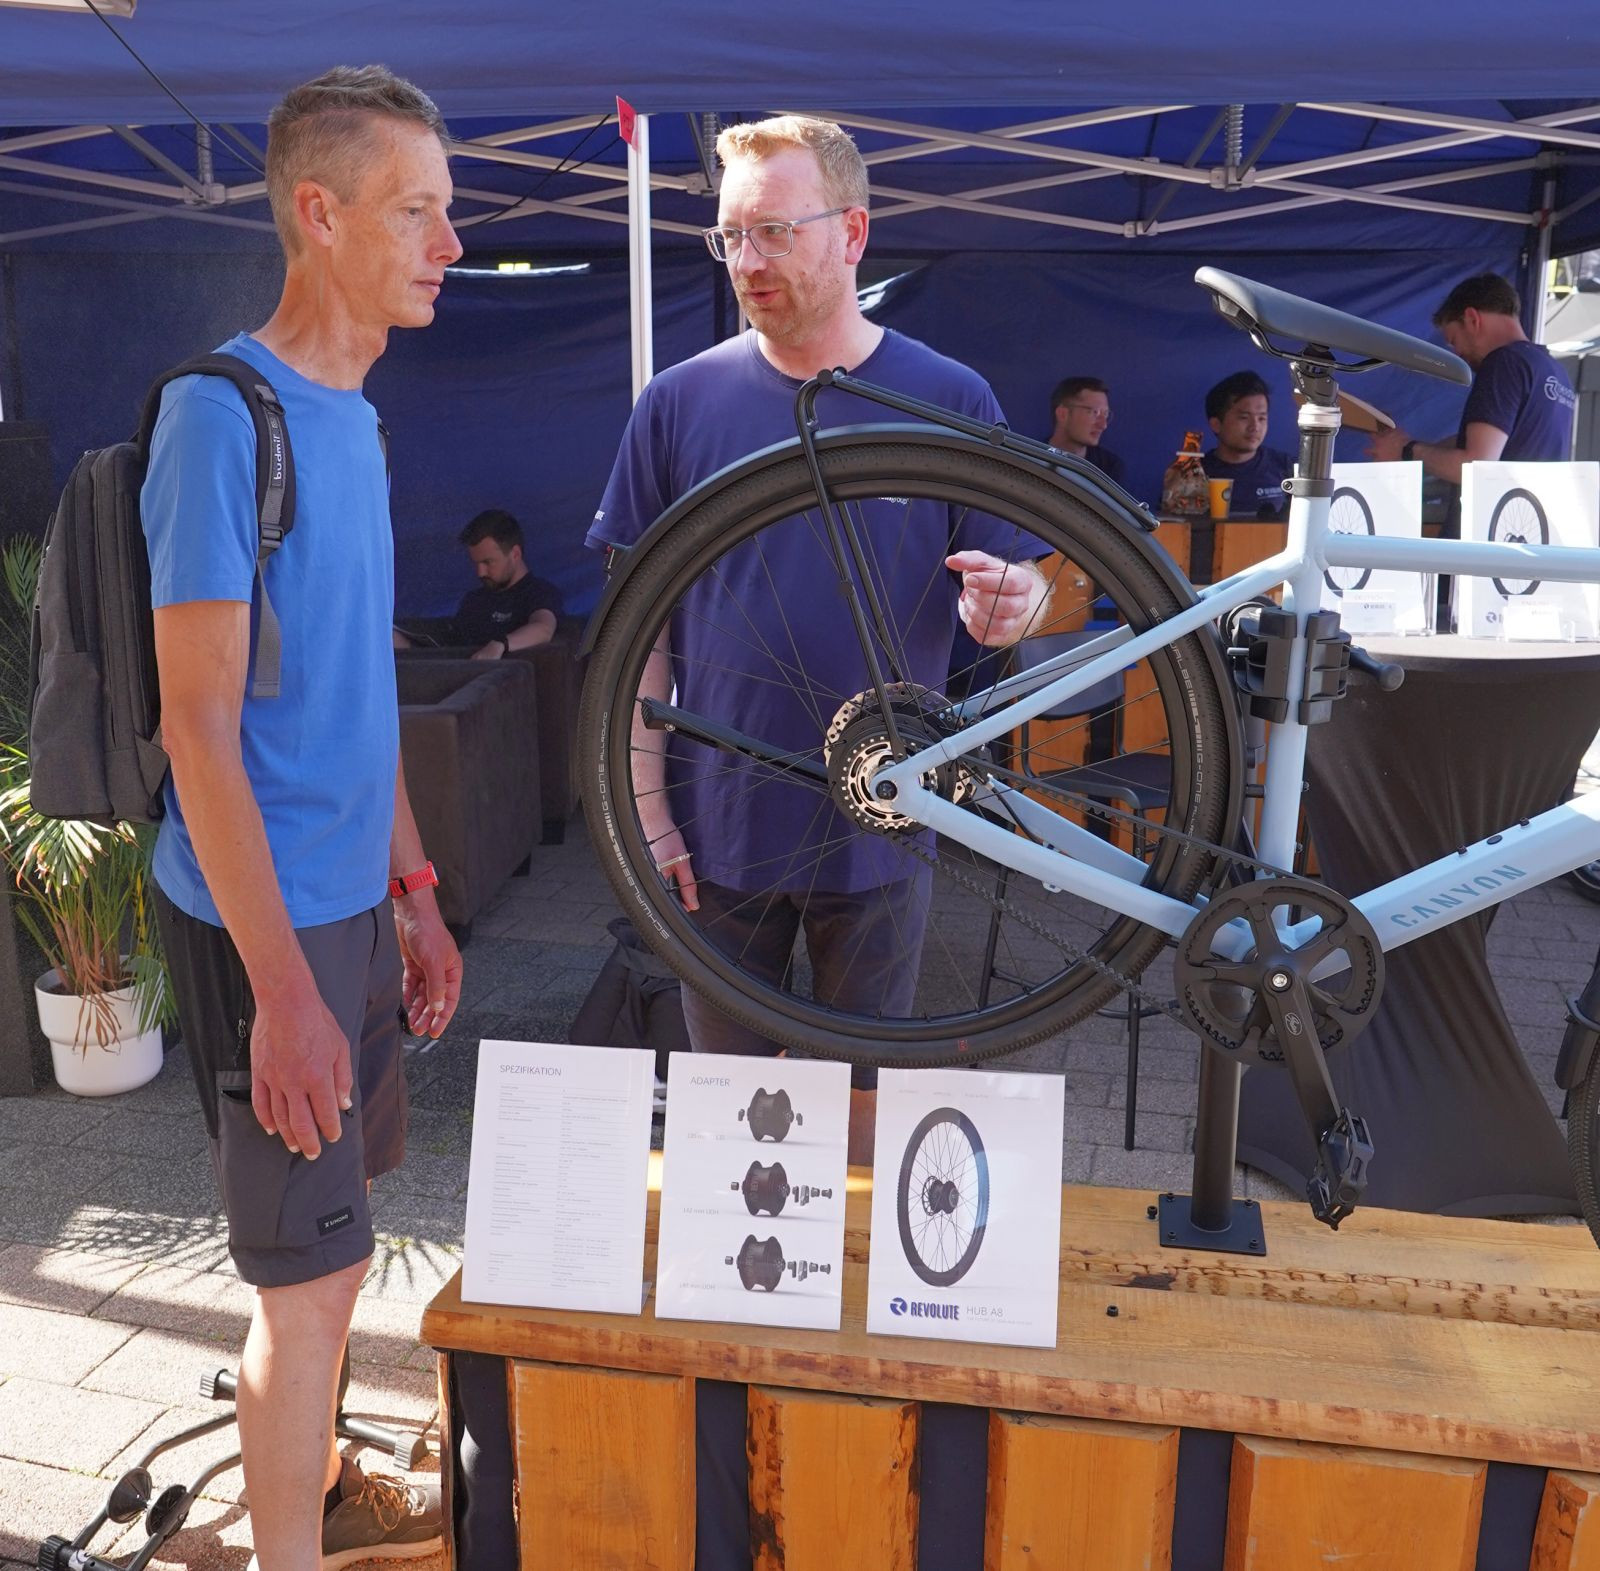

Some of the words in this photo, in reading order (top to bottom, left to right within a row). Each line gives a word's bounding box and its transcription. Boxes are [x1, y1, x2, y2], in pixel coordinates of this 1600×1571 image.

[273, 434, 283, 480] budmil
[600, 711, 608, 761] ALLROUND
[598, 763, 609, 811] G-ONE
[1195, 752, 1204, 803] G-ONE
[622, 866, 670, 940] SCHWALBE
[1390, 864, 1527, 928] CANYON
[499, 1064, 562, 1077] SPEZIFIKATION
[690, 1076, 731, 1088] ADAPTER
[910, 1301, 960, 1320] REVOLUTE
[966, 1305, 988, 1316] HUB
[990, 1307, 1004, 1318] A8
